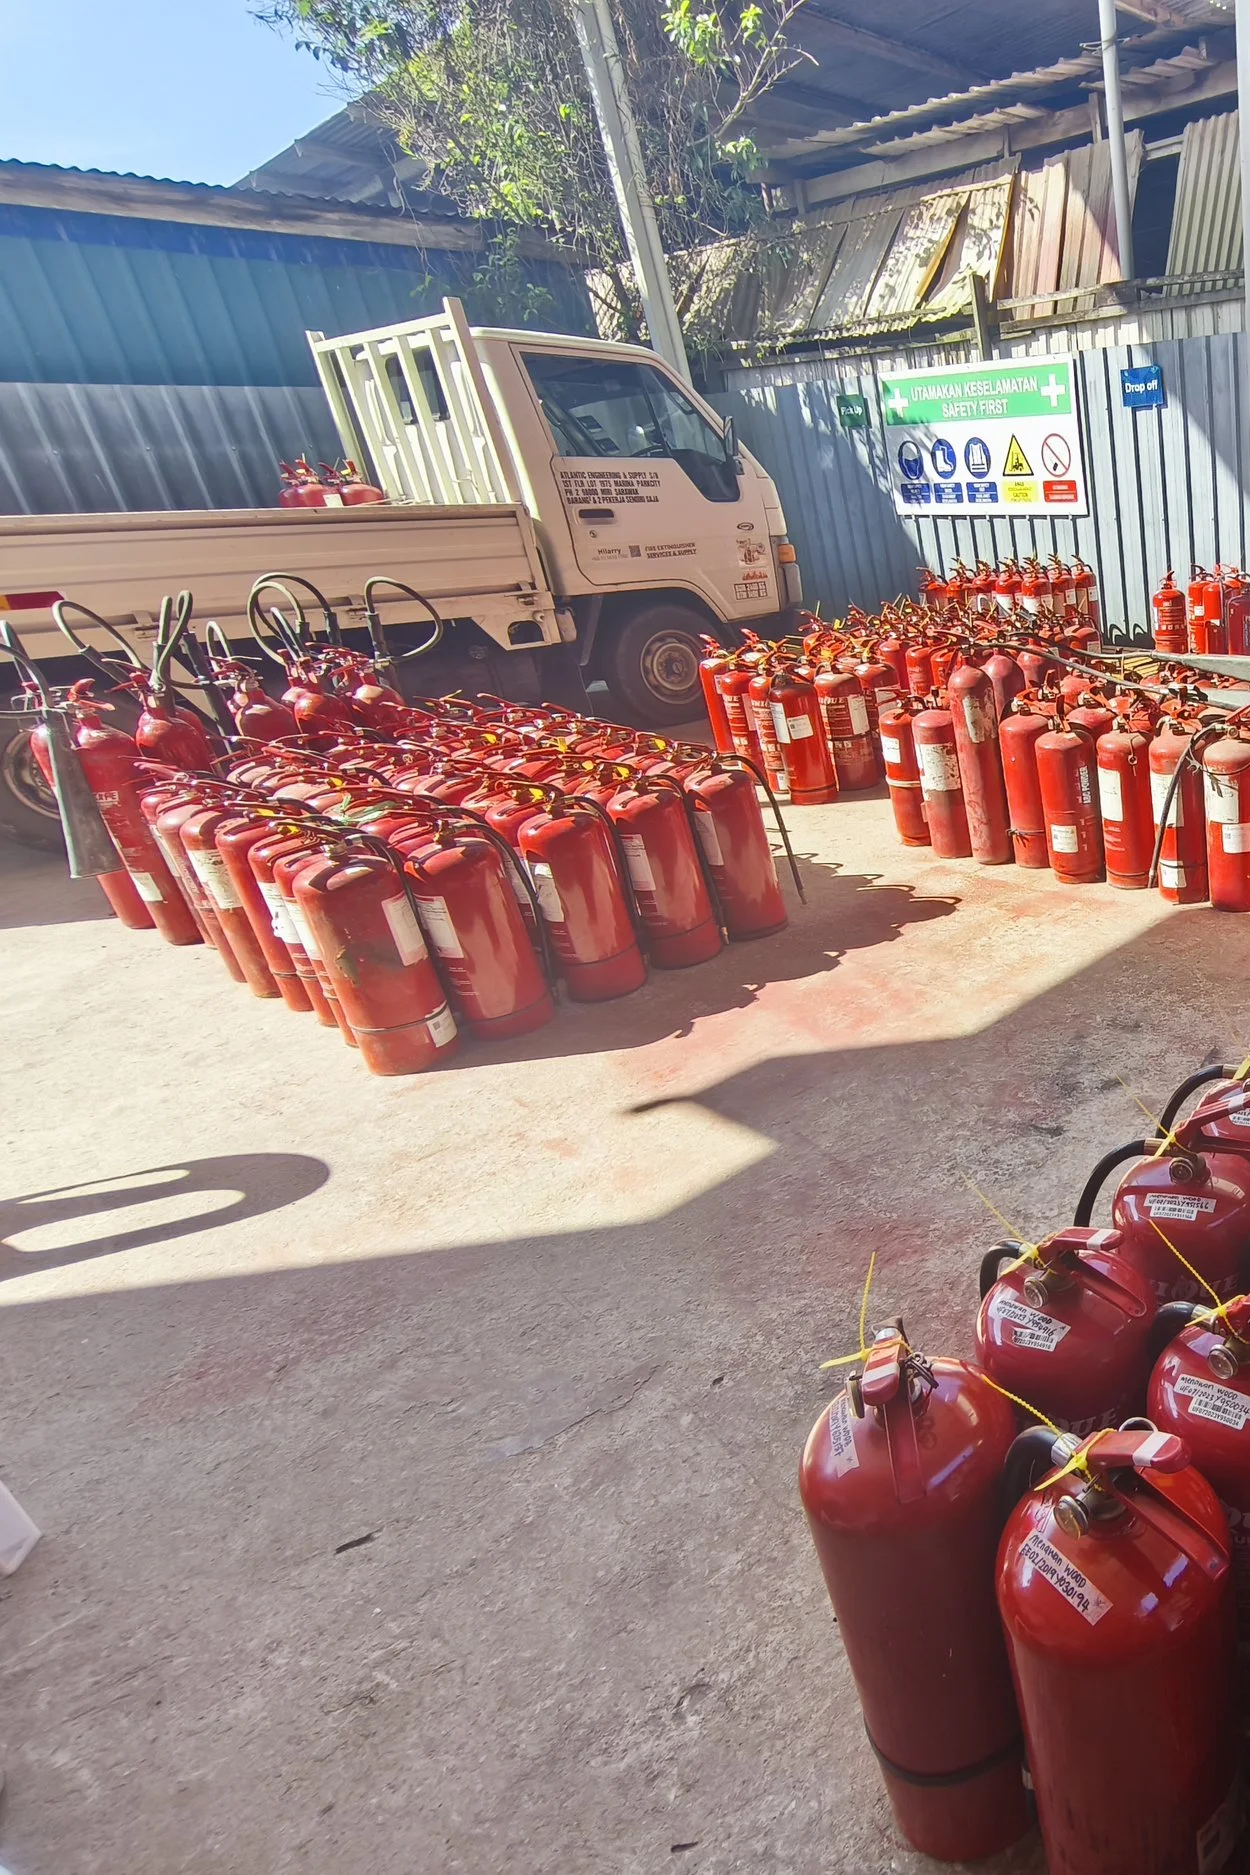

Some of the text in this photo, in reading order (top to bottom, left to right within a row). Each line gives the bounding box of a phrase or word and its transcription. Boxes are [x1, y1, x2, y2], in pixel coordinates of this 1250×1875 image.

[911, 375, 1038, 401] UTAMAKAN KESELAMATAN
[1125, 379, 1158, 394] Drop off
[941, 398, 1008, 418] SAFETY FIRST
[559, 471, 587, 480] ATLANTIC
[587, 471, 622, 480] ENGINEERING
[628, 471, 648, 480] SUPPLY
[587, 480, 597, 488] LOT
[614, 488, 640, 496] SARAWAK
[657, 542, 696, 552] EXTINGUISHER
